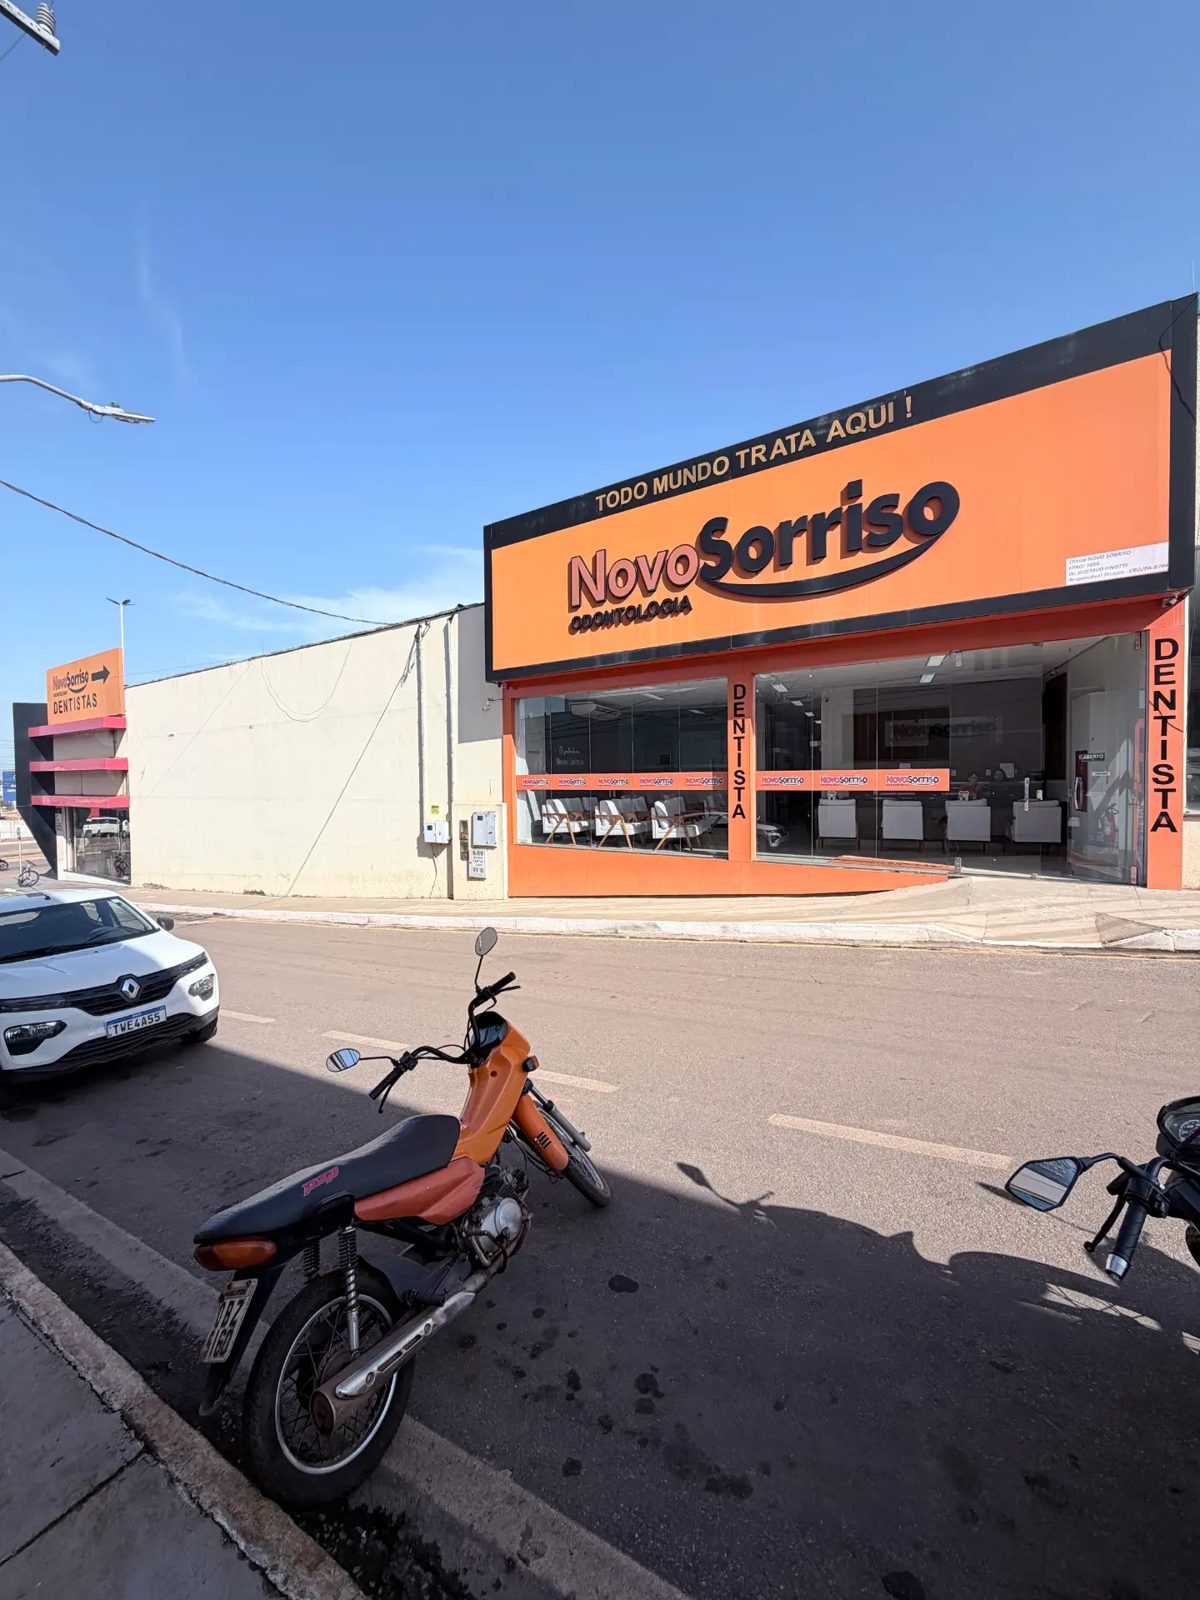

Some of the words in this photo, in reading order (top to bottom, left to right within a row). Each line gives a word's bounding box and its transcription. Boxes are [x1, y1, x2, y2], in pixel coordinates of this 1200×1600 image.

[595, 481, 649, 512] TODO
[653, 455, 730, 495] MUNDO
[735, 428, 817, 469] TRATA
[826, 401, 895, 443] AQUI
[571, 595, 692, 630] ODONTOLOGIA
[53, 693, 97, 714] DENTISTAS
[1150, 637, 1180, 833] DENTISTA
[732, 683, 747, 819] DENTISTA
[112, 1012, 161, 1035] TWE4A55
